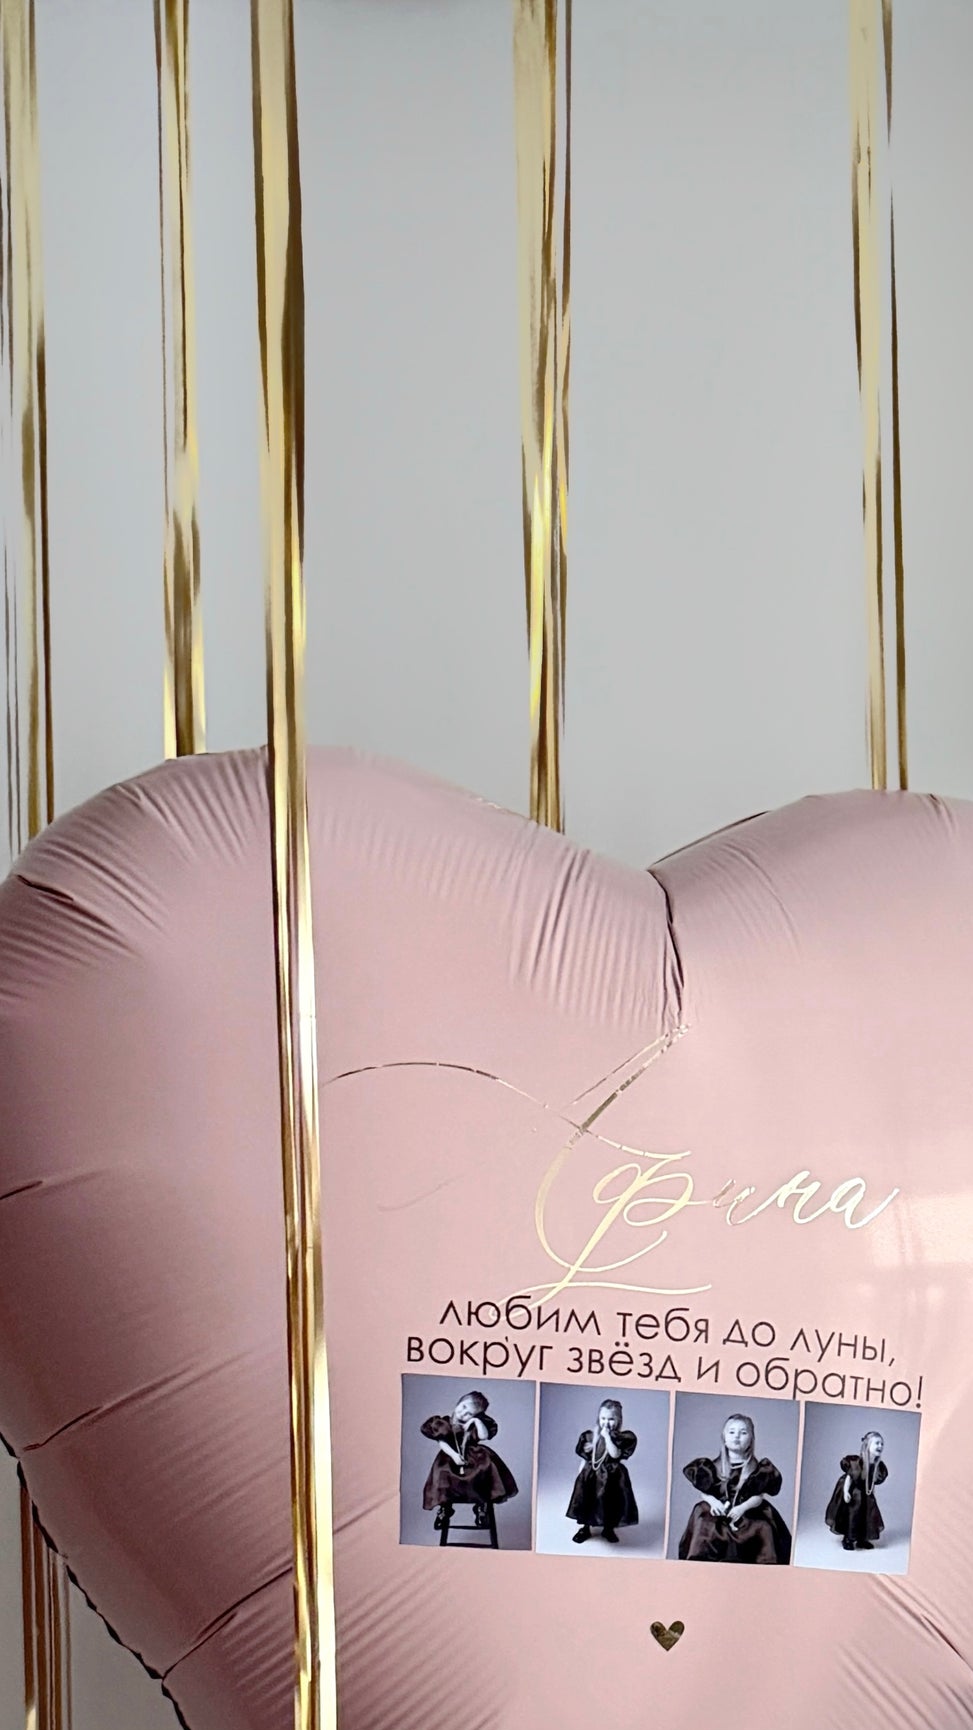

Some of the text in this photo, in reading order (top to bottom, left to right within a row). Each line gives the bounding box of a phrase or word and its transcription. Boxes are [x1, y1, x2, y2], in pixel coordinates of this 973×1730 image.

[439, 1295, 896, 1367] любим тебя до луны,
[406, 1336, 924, 1409] вокруг звёзд и обратно!
